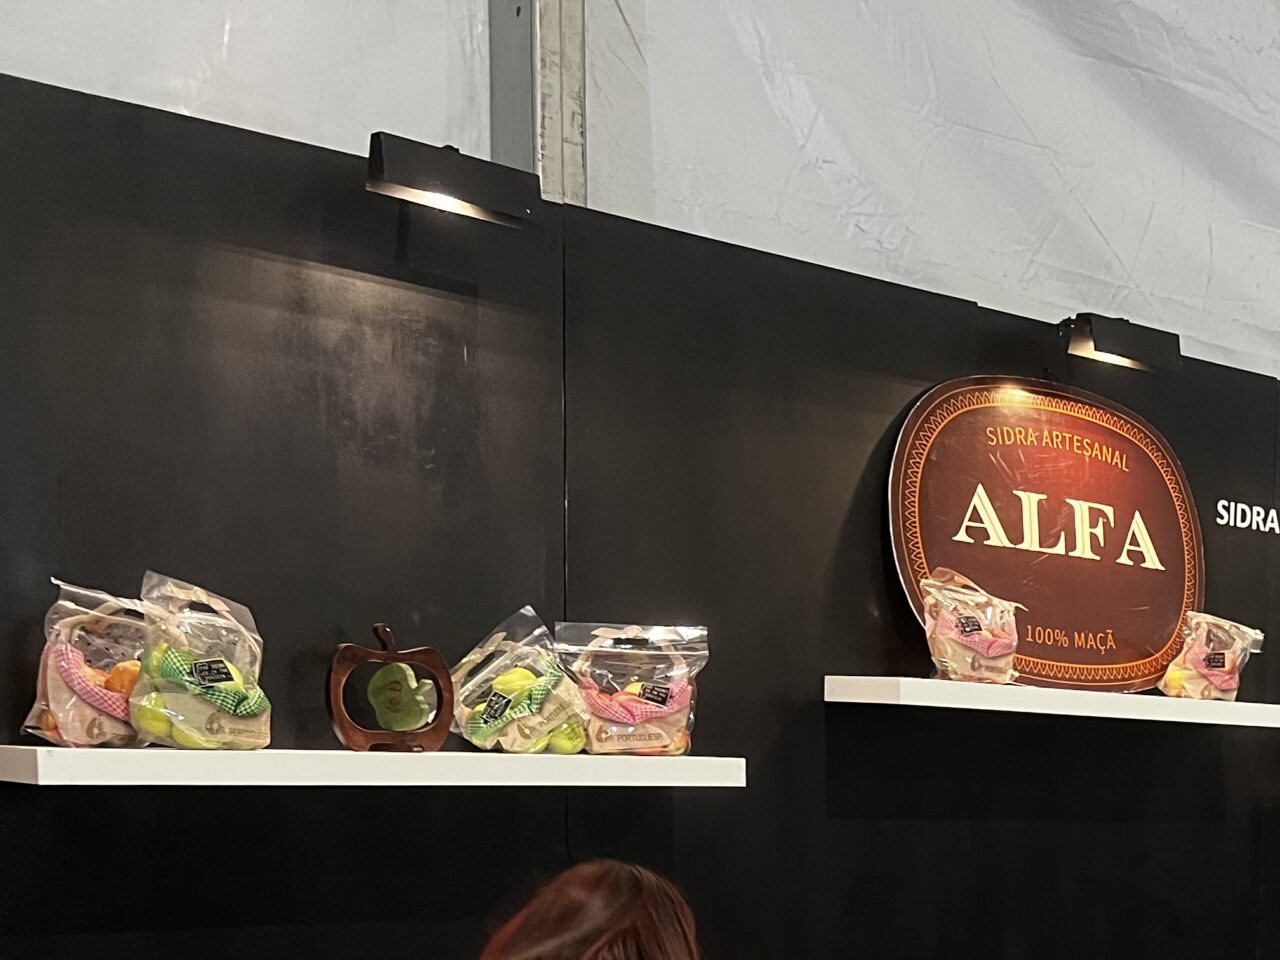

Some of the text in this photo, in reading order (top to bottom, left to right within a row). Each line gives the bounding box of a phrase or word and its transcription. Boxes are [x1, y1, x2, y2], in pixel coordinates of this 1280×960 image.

[986, 426, 1130, 473] SIDRA ARTESANAL
[952, 482, 1166, 571] ALFA
[1216, 499, 1280, 534] SIDRA
[1025, 624, 1117, 655] 100% MAÇÃ
